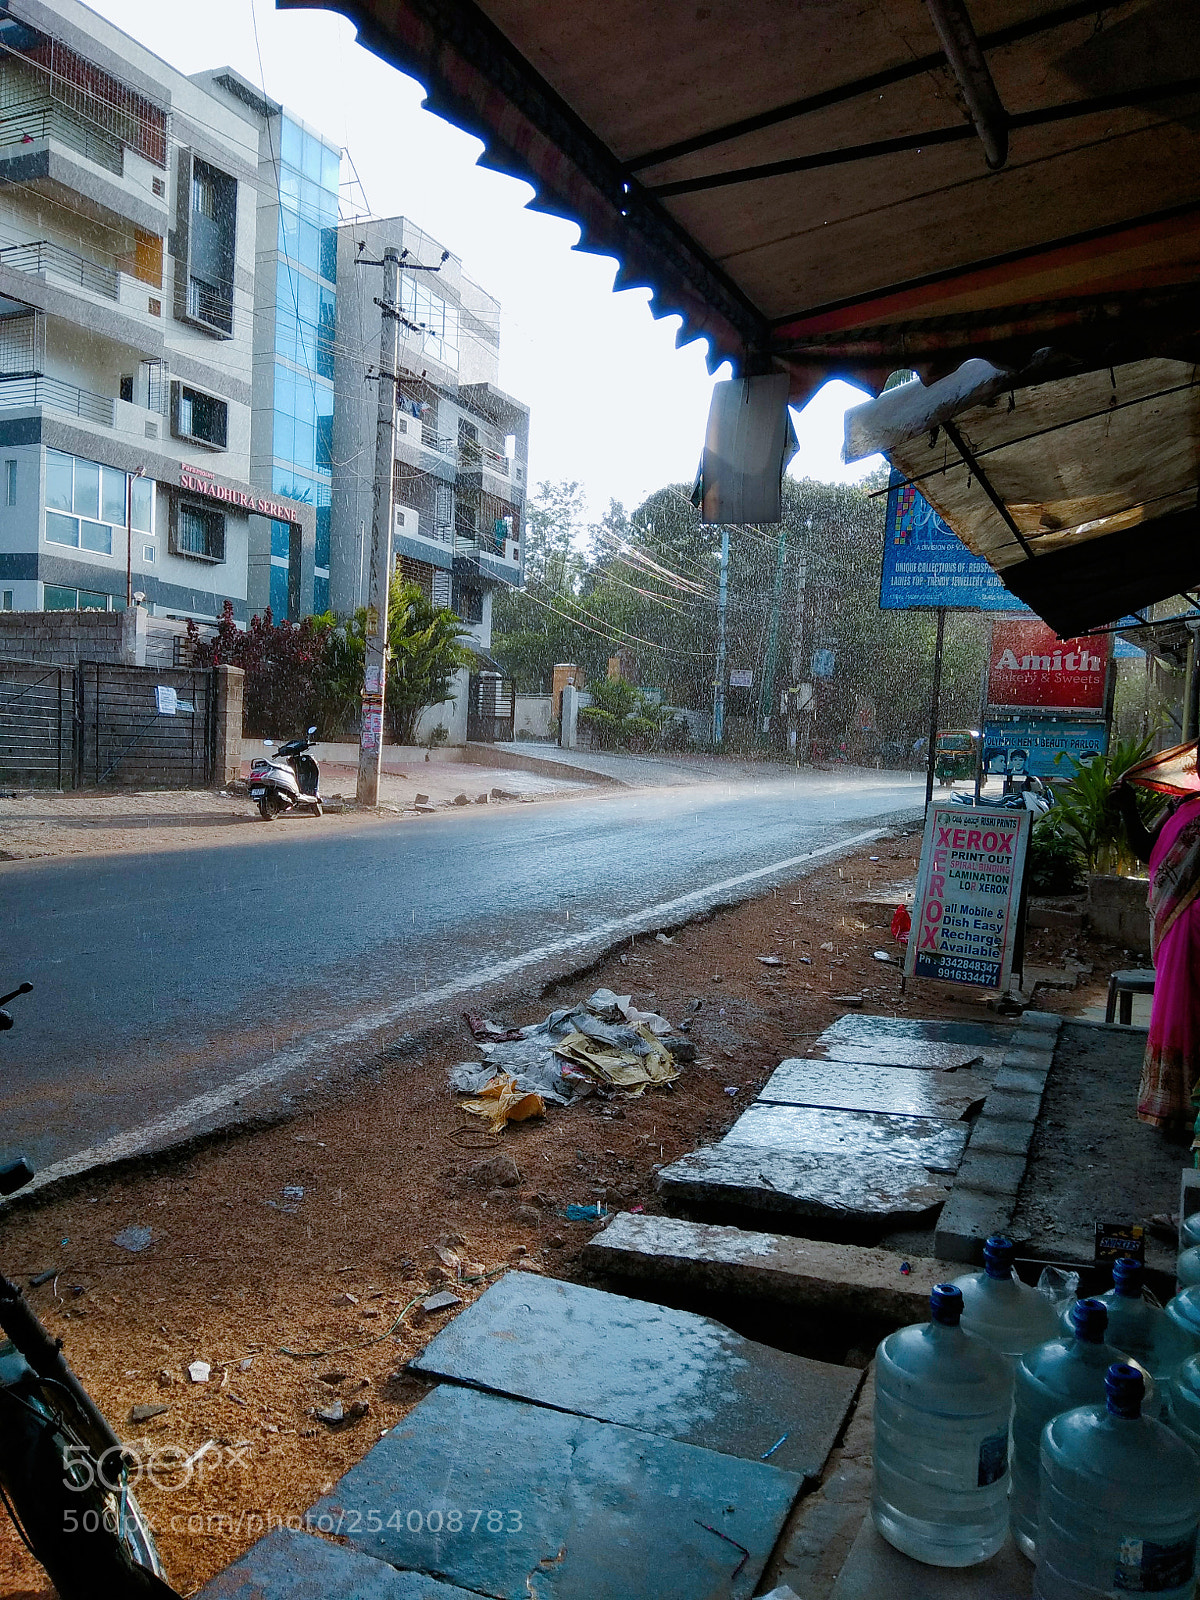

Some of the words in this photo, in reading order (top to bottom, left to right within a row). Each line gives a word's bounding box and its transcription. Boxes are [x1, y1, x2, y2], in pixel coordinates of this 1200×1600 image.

[181, 462, 215, 481] Paramount
[180, 474, 256, 511] SUMADHURA
[257, 498, 298, 521] SERENE
[895, 562, 917, 573] UNIQUE
[917, 562, 957, 573] COLLECTIONS
[891, 576, 911, 586] LADIES
[912, 576, 923, 586] TOP
[927, 576, 950, 587] TRENDY
[951, 576, 984, 587] JEWELLERY
[994, 648, 1101, 672] Amith
[992, 671, 1038, 685] Bakery
[1041, 672, 1050, 683] &
[1053, 672, 1101, 684] Sweets
[986, 736, 1017, 747] OLYMPIC
[1040, 738, 1069, 749] BEAUTY
[1070, 739, 1100, 750] PARLOR
[980, 816, 996, 827] RISHI
[996, 818, 1017, 829] PRINTS
[935, 827, 1014, 854] XEROX
[951, 850, 985, 862] PRINT
[987, 854, 1013, 864] OUT
[949, 860, 977, 871] SPIRAL
[978, 862, 1011, 874] BINDING
[948, 869, 1010, 885] LAMINATION
[978, 882, 1009, 895] XEROX
[944, 903, 958, 914] all
[959, 904, 994, 918] Mobile
[996, 908, 1005, 919] &
[942, 915, 970, 928] Dish
[973, 919, 1004, 934] Easy
[941, 927, 1003, 946] Recharge
[939, 940, 1000, 959] Available
[918, 953, 931, 964] Ph
[940, 956, 999, 974] 9342848347
[937, 967, 997, 986] 9916334471
[1099, 1237, 1142, 1252] SNICKERS
